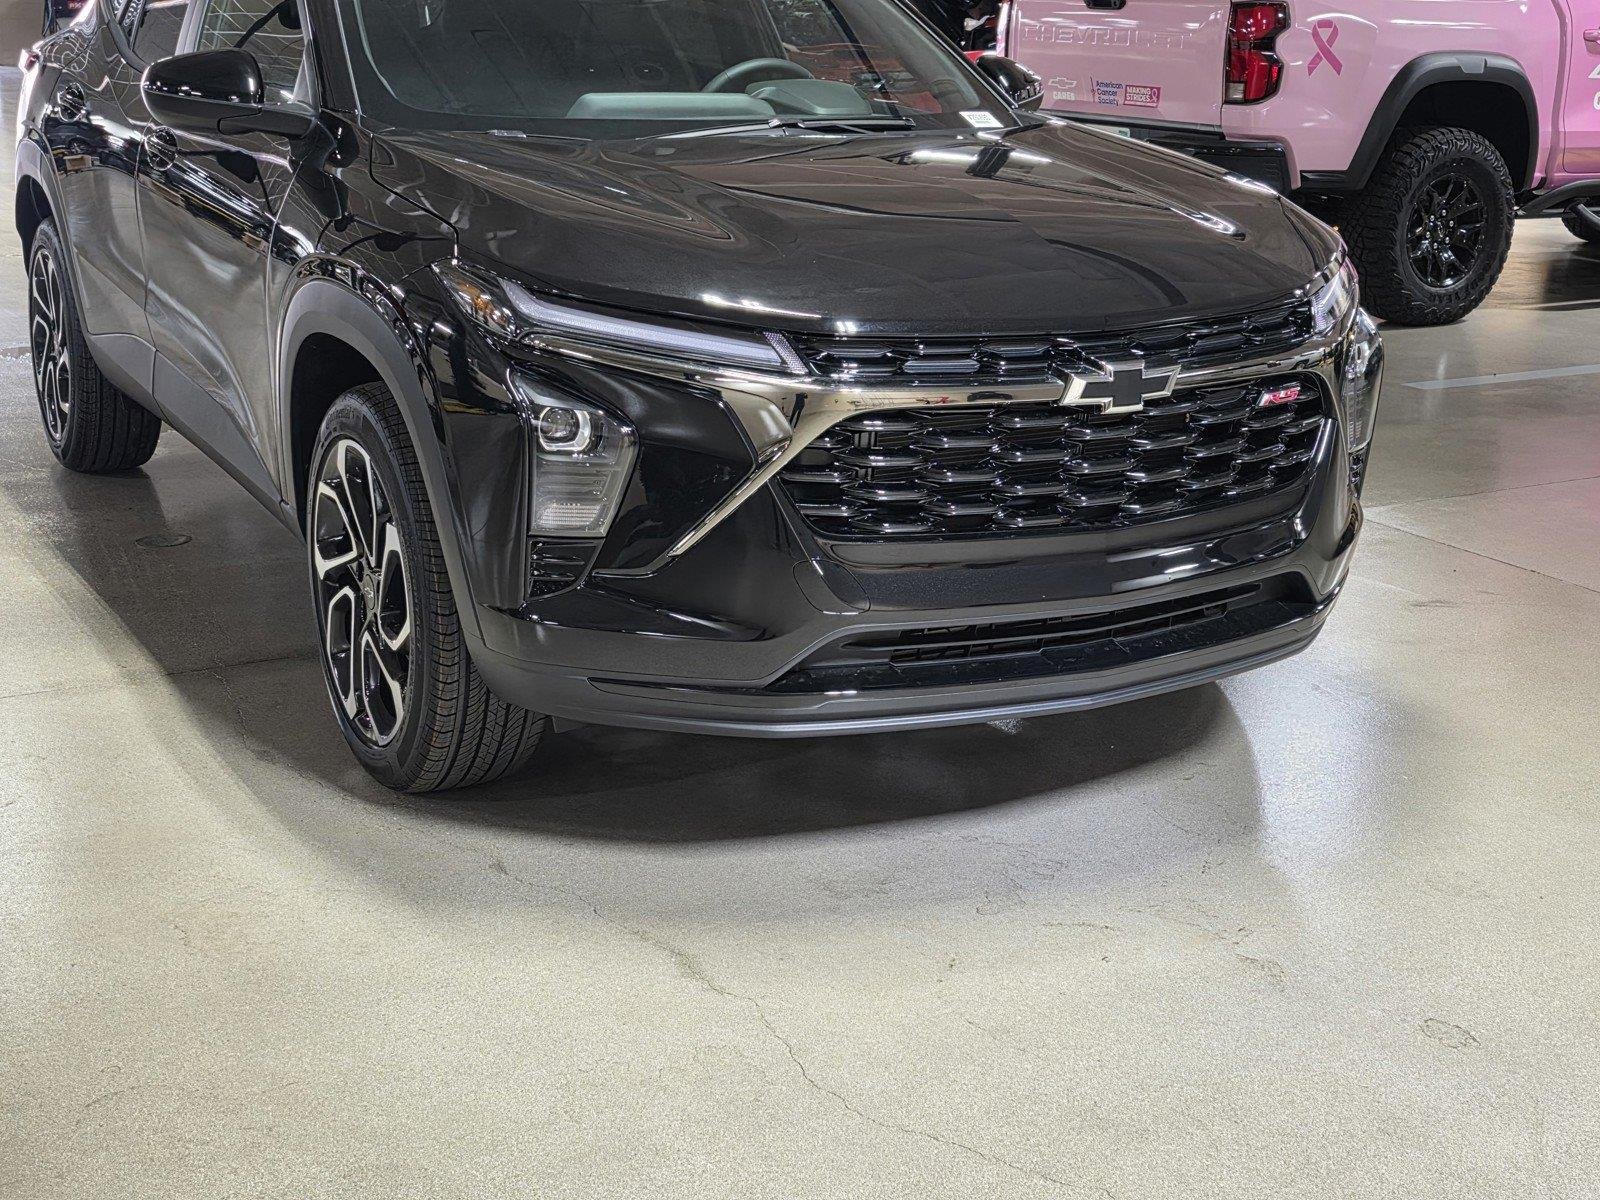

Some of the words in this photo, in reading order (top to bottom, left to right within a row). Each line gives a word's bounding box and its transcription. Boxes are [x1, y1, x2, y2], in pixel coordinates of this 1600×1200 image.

[1023, 24, 1193, 49] CHEVROLET
[1096, 81, 1124, 90] American
[1097, 88, 1118, 97] Cancer
[1126, 86, 1151, 95] MAKING
[1098, 96, 1119, 107] Society
[1125, 94, 1151, 103] STRIDES
[1259, 387, 1300, 407] RS
